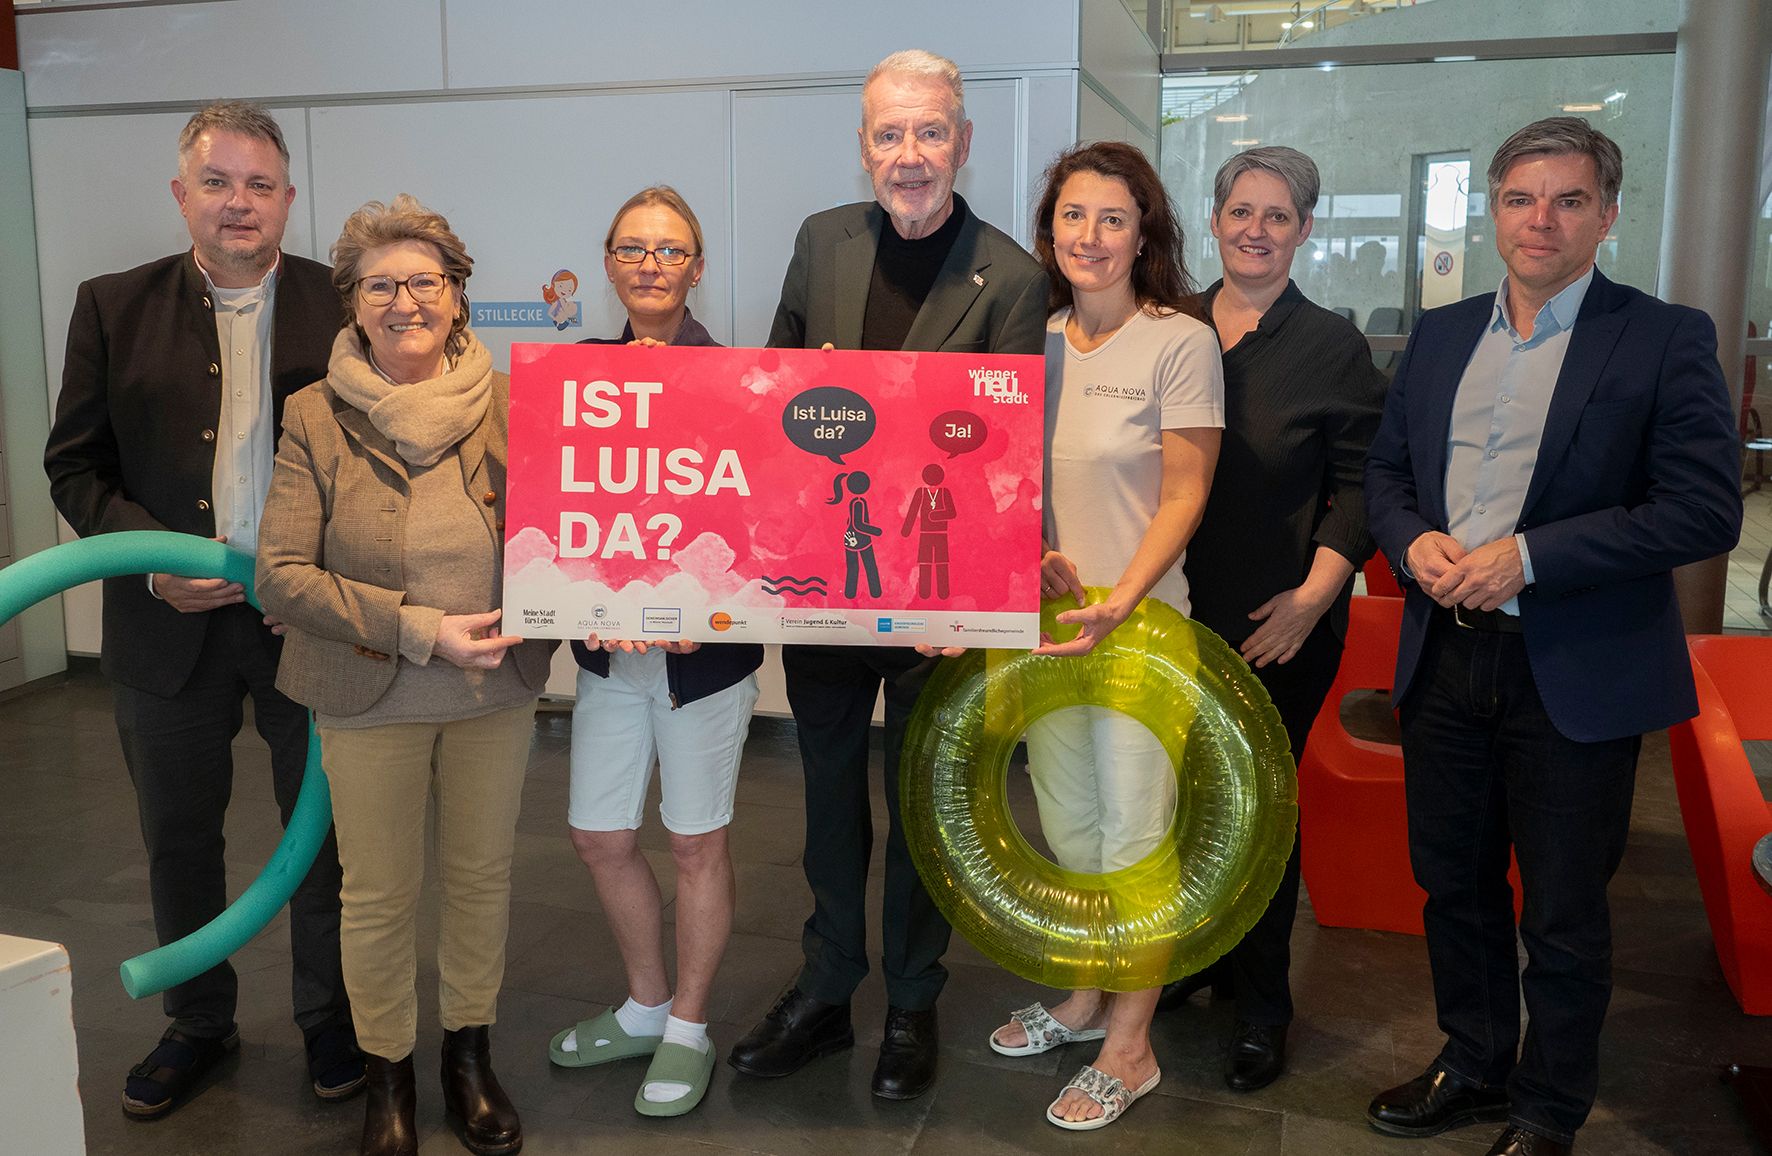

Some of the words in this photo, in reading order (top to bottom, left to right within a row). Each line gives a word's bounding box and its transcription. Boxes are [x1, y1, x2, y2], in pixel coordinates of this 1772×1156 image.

[477, 309, 544, 321] STILLECKE
[968, 366, 1017, 380] wiener
[974, 377, 1018, 396] neu
[1095, 384, 1119, 394] AQUA
[1122, 387, 1146, 397] NOVA
[562, 380, 663, 428] IST
[993, 391, 1029, 404] stadt
[793, 405, 816, 421] Ist
[820, 405, 867, 422] Luisa
[813, 425, 846, 440] da?
[944, 423, 972, 439] Ja!
[561, 446, 751, 496] LUISA
[559, 511, 683, 560] DA?
[523, 608, 539, 617] Meine
[540, 608, 556, 617] Stadt
